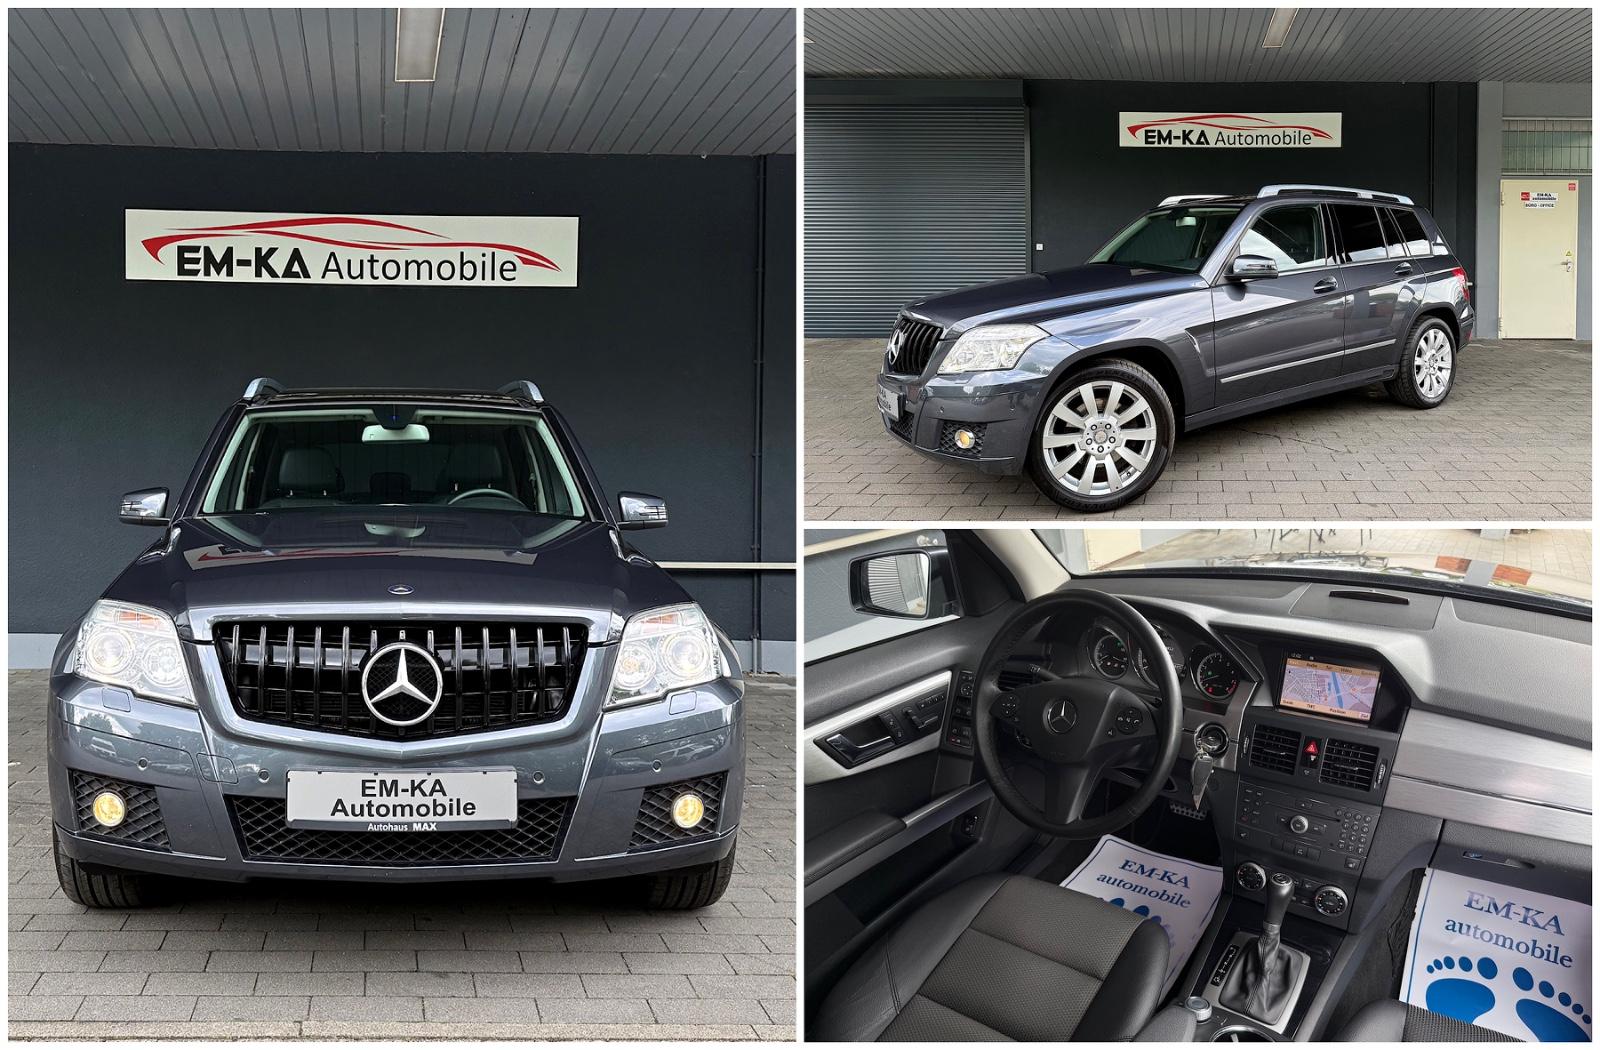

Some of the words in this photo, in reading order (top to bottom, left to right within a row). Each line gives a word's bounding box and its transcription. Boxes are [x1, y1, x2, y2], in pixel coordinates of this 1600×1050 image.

[1144, 129, 1210, 146] EM-KA
[1214, 130, 1312, 146] Automobile
[176, 245, 311, 279] EM-KA
[321, 251, 517, 281] Automobile
[360, 778, 447, 798] EM-KA
[330, 798, 477, 818] Automobile
[367, 822, 408, 832] Autohaus
[412, 822, 438, 832] MAX
[1118, 859, 1191, 889] EM-KA
[1096, 873, 1192, 908] automobile
[1463, 890, 1566, 936] EM-KA
[1444, 918, 1574, 968] automobile
